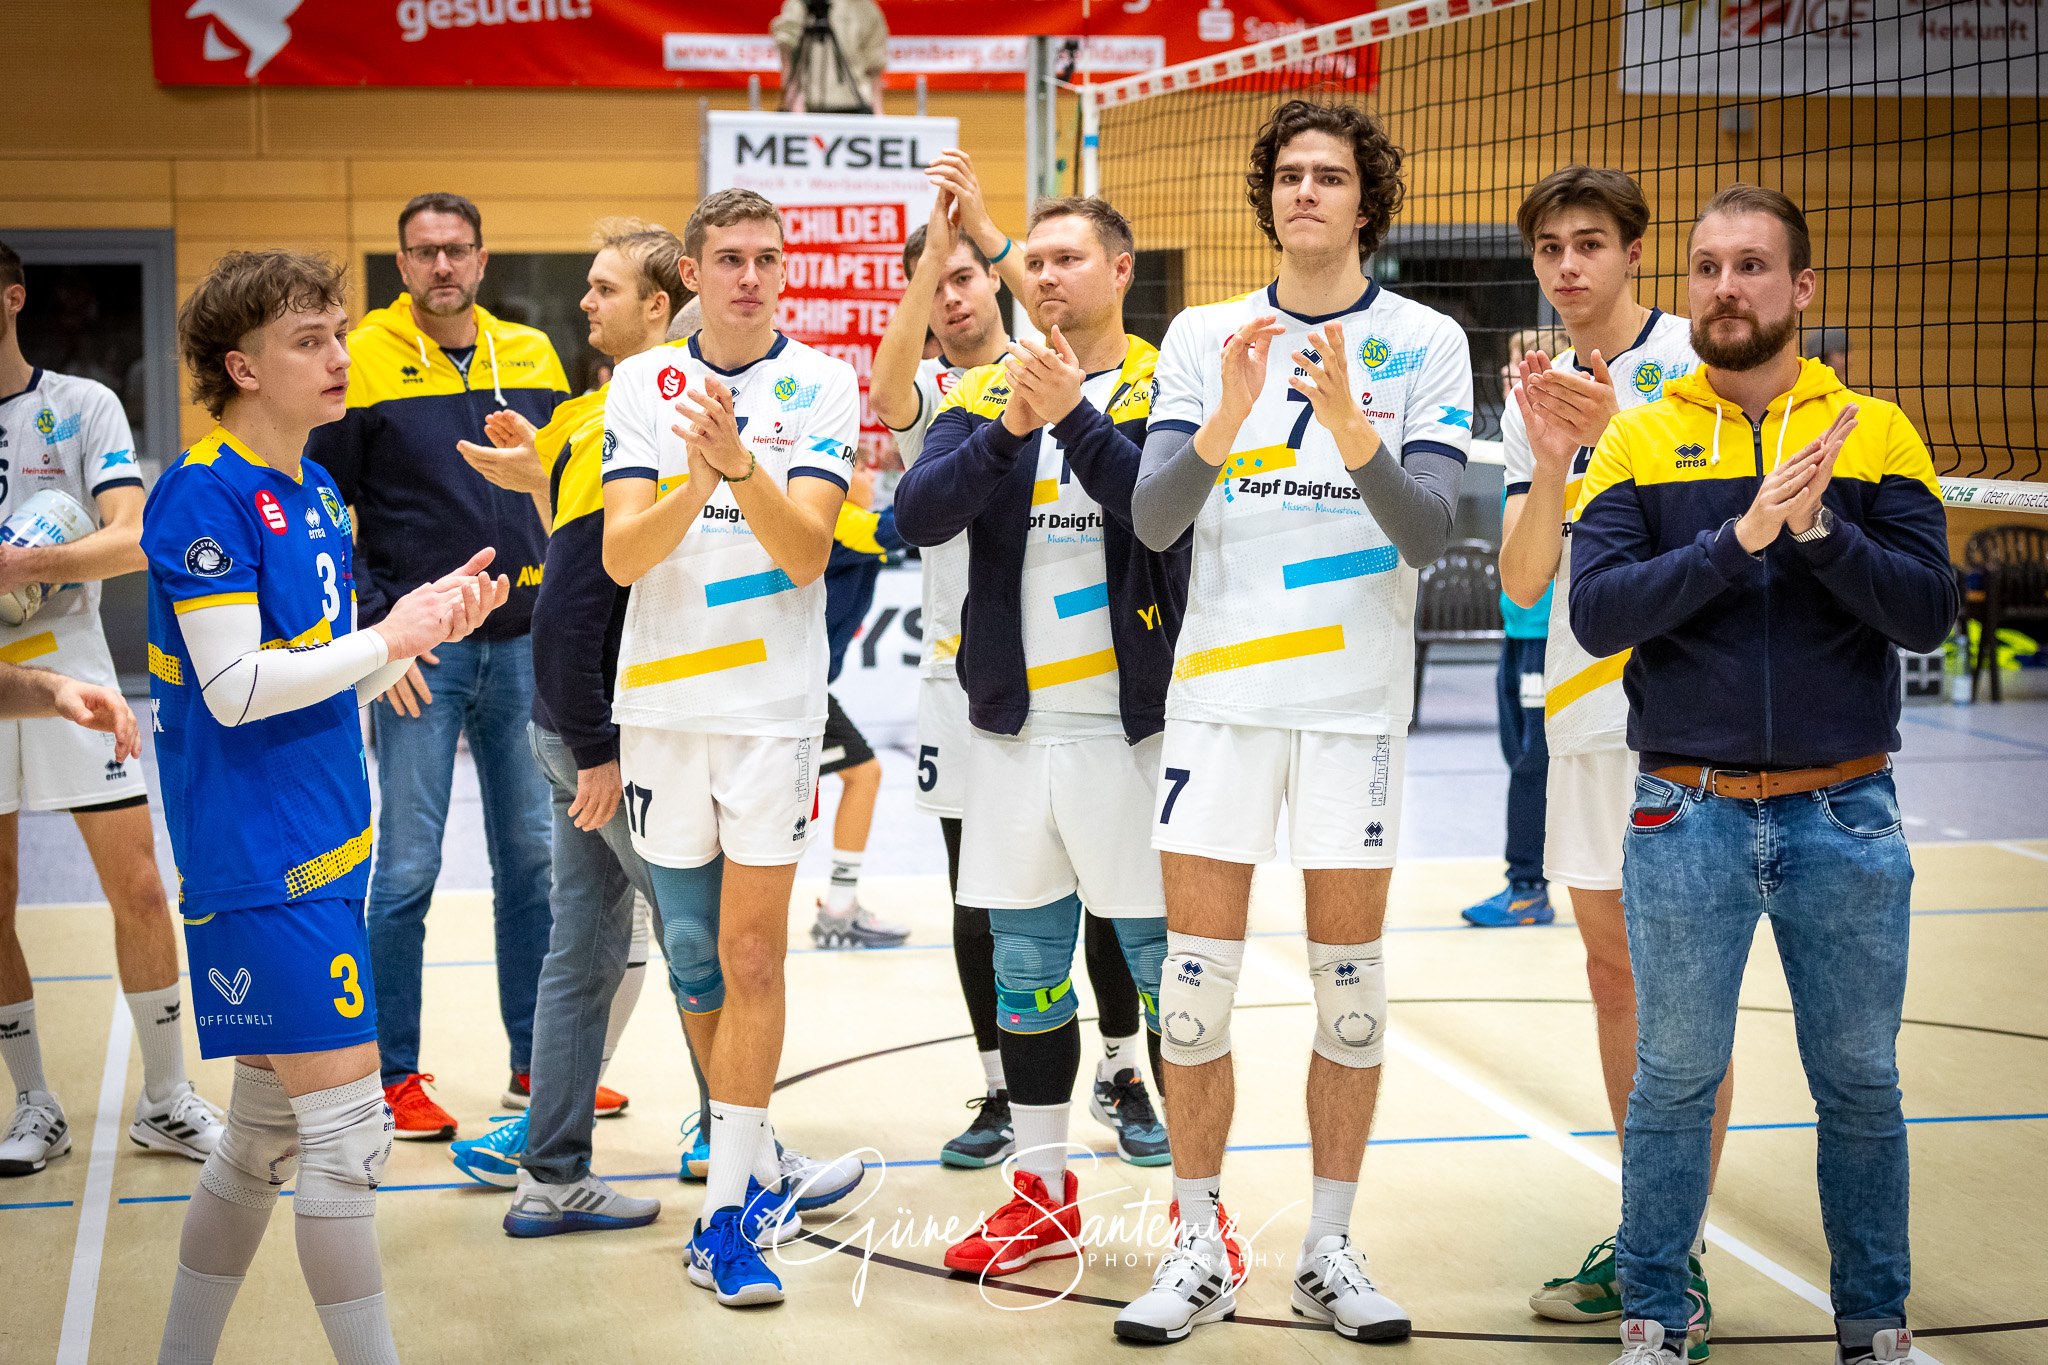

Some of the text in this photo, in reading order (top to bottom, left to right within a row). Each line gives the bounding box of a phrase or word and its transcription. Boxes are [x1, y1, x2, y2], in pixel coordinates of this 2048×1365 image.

[1918, 18, 2028, 40] Herkunft
[736, 133, 931, 169] MEYSEL
[786, 252, 908, 290] OTAPETE
[1286, 388, 1314, 450] 7
[1675, 458, 1707, 469] errea
[1239, 478, 1361, 500] Zapf Daigfuss
[1981, 486, 2009, 505] Ideen
[703, 504, 745, 523] Daig
[1049, 513, 1104, 532] Daigfu
[308, 527, 326, 540] errea
[316, 552, 340, 622] 3
[918, 744, 939, 792] 5
[1160, 767, 1191, 825] 7
[623, 780, 653, 839] 17
[1363, 838, 1383, 847] errea
[330, 952, 365, 1018] 3
[199, 1014, 273, 1027] OFFICEWELT
